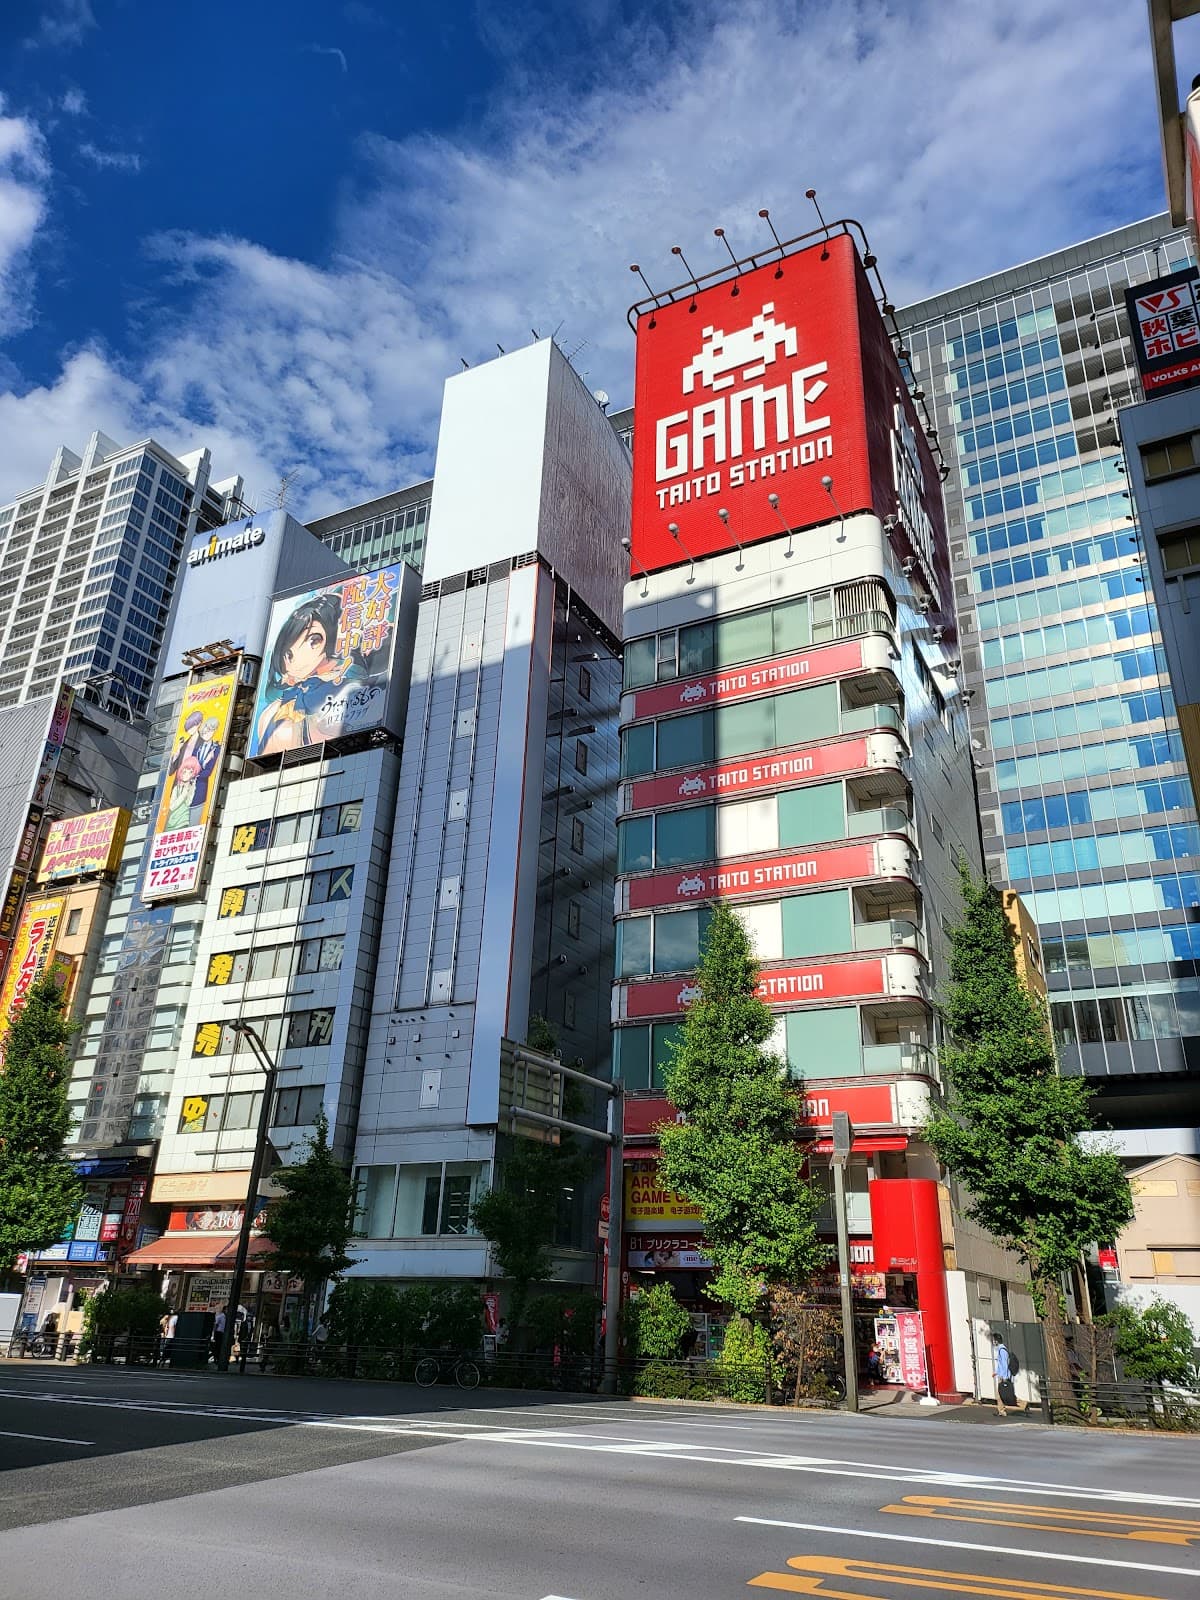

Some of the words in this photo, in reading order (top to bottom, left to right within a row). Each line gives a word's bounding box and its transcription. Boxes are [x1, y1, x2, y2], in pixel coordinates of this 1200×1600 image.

[1152, 367, 1189, 383] VOLKS
[655, 360, 831, 483] GAME
[656, 471, 721, 510] TAITO
[729, 435, 833, 488] STATION
[187, 527, 263, 563] animate
[361, 571, 395, 653] 大好評
[709, 676, 747, 695] TAITO
[751, 660, 810, 685] STATION
[709, 769, 748, 788] TAITO
[752, 756, 813, 780] STATION
[47, 834, 80, 855] GAME
[80, 828, 113, 848] BOOK
[159, 829, 200, 845] 過去最高に
[150, 867, 180, 887] 7.22
[708, 873, 748, 890] TAITO
[754, 860, 817, 883] STATION
[631, 1191, 671, 1204] GAME
[904, 1337, 922, 1387] 営業中
